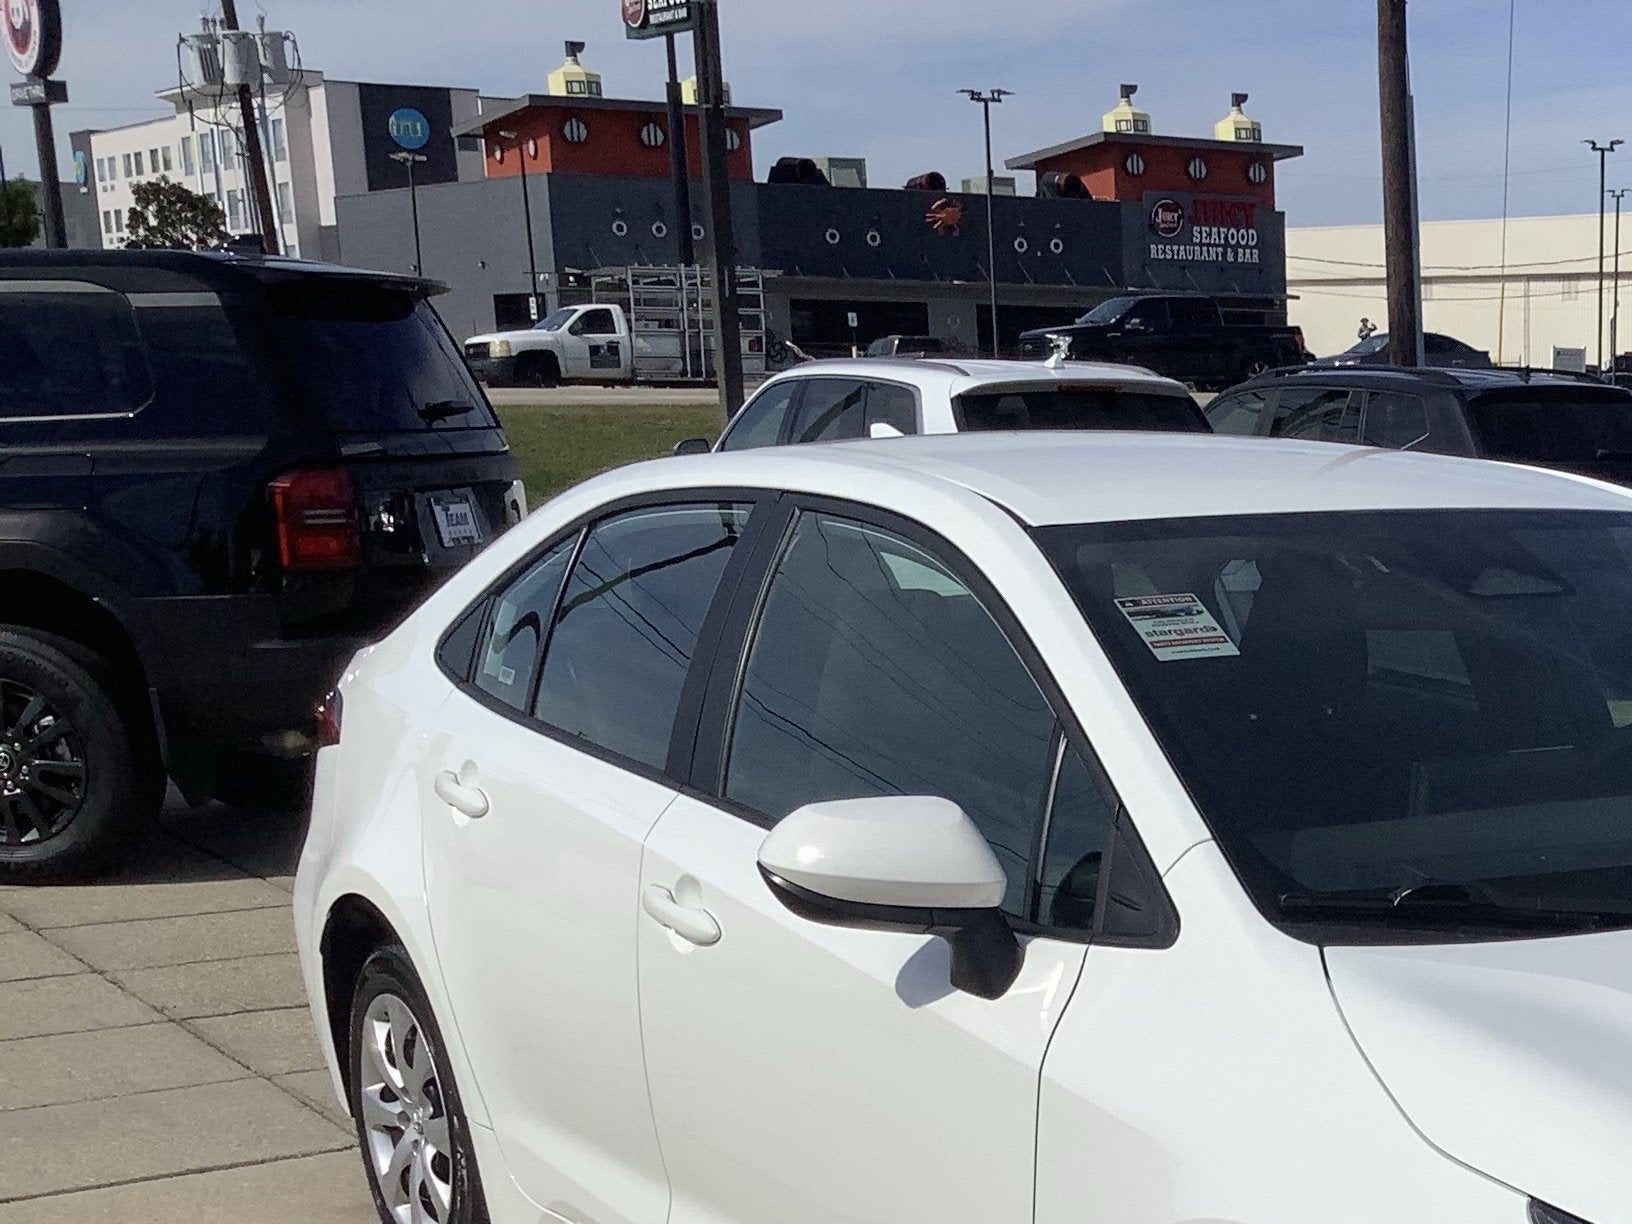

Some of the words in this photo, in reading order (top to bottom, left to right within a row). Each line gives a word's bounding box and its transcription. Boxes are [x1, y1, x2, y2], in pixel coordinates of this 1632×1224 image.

[1192, 226, 1258, 246] SEAFOOD
[1150, 244, 1223, 261] RESTAURANT
[1226, 247, 1235, 262] &
[1237, 248, 1259, 263] BAR
[1141, 596, 1194, 606] ATTENTION
